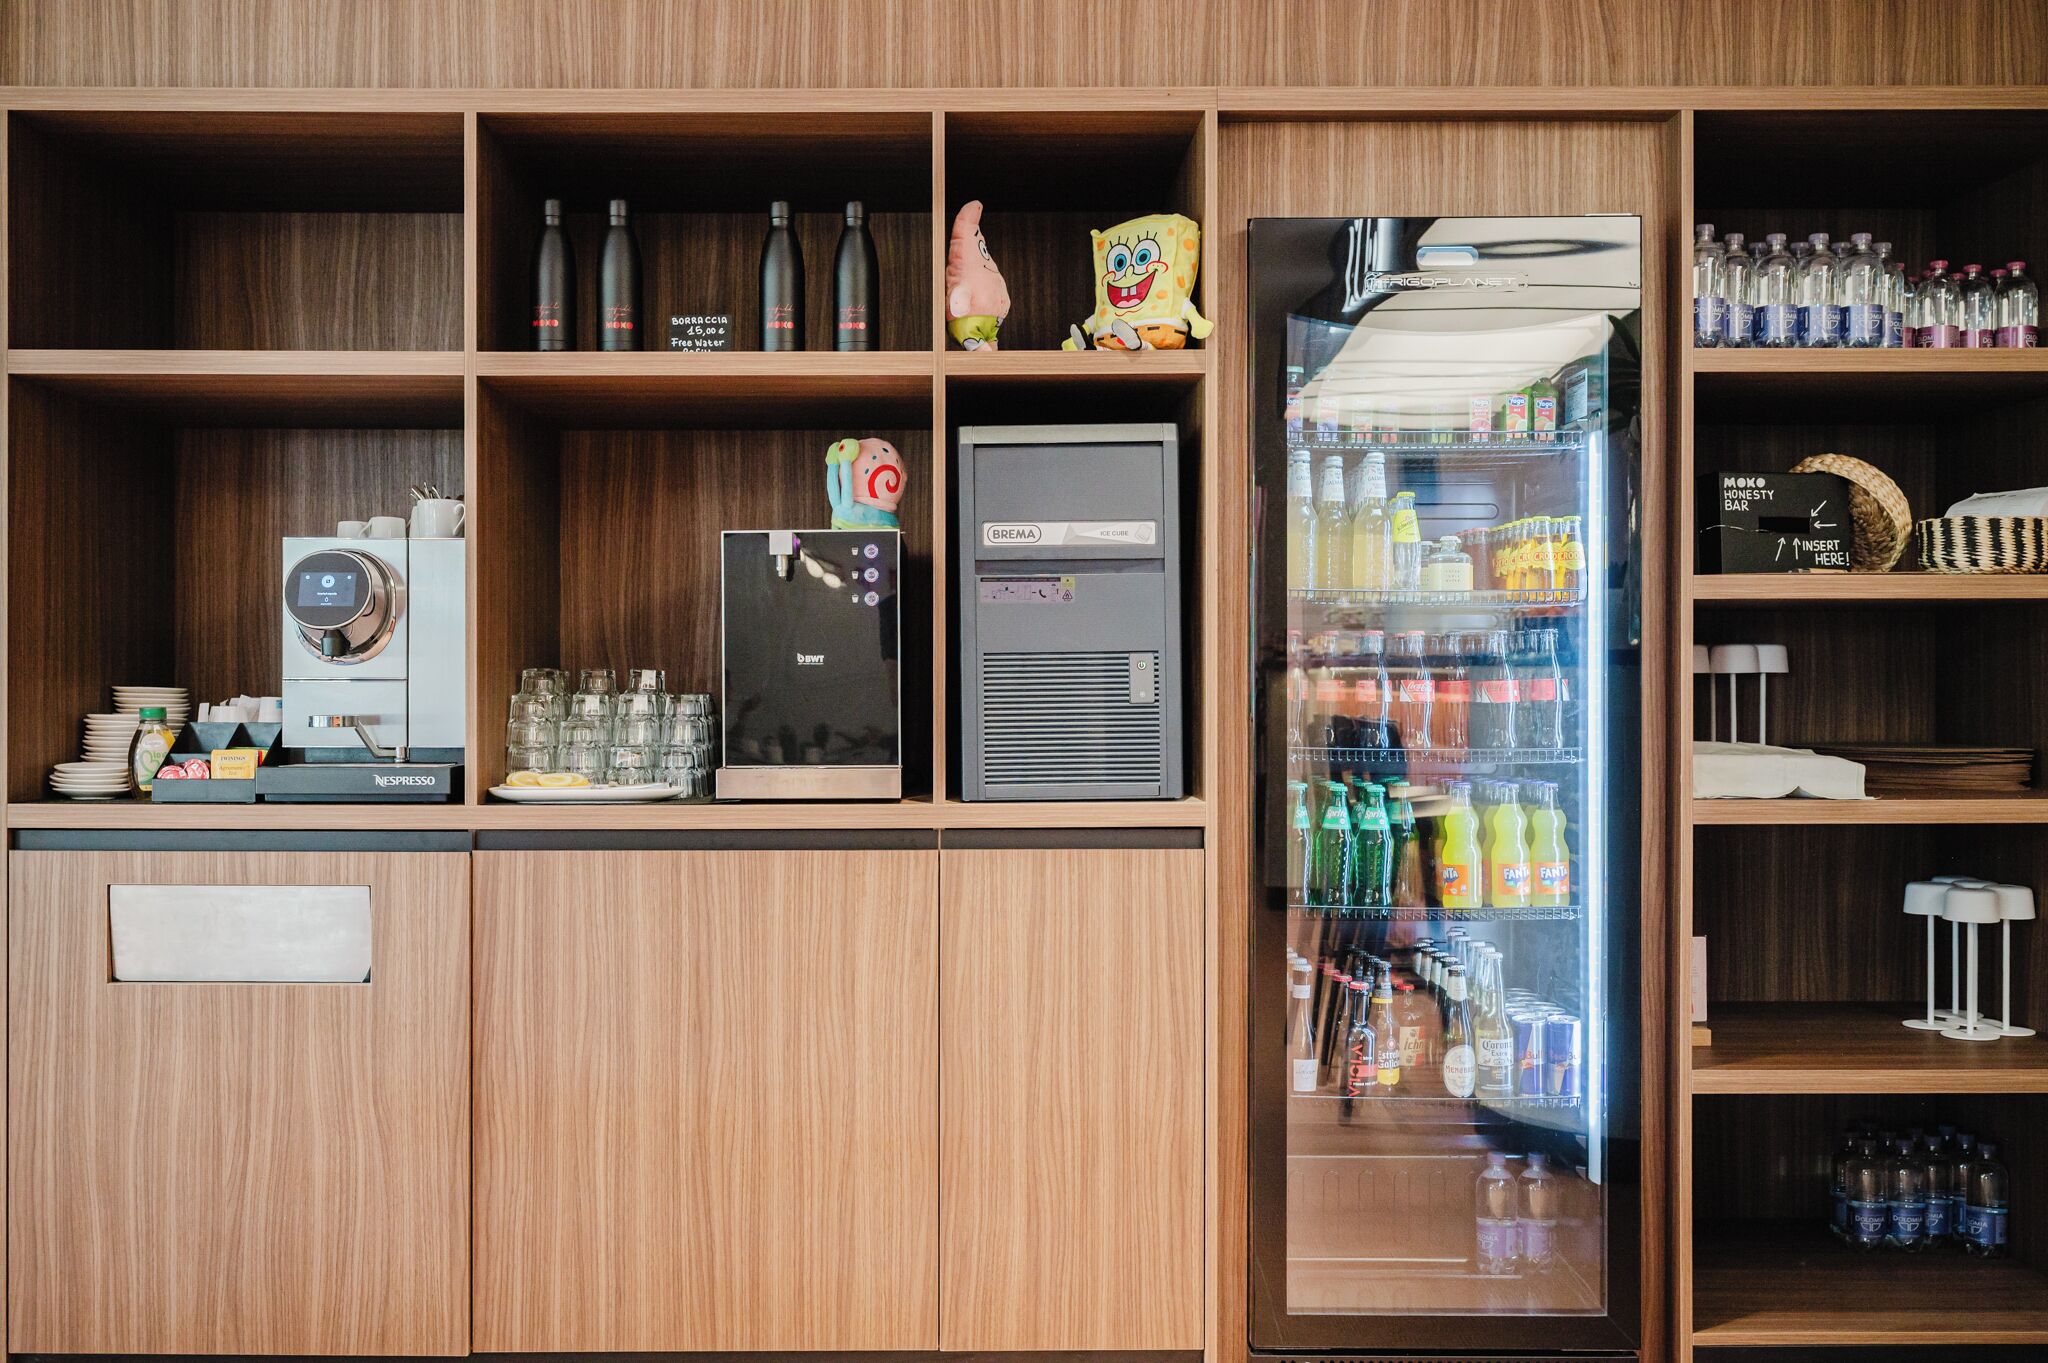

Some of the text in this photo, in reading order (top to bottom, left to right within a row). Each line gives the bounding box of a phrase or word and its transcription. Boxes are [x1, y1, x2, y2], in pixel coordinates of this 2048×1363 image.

[671, 316, 728, 325] BORRACCIA
[686, 325, 716, 337] 15,00
[671, 337, 725, 348] Free Water
[1723, 477, 1766, 489] MOKO
[1723, 489, 1775, 501] HONESTY
[1724, 500, 1750, 512] BAR
[992, 529, 1036, 539] BREMA
[1802, 539, 1841, 552] INSERT
[1815, 551, 1851, 567] HERE!
[372, 774, 436, 787] NESPRESSO
